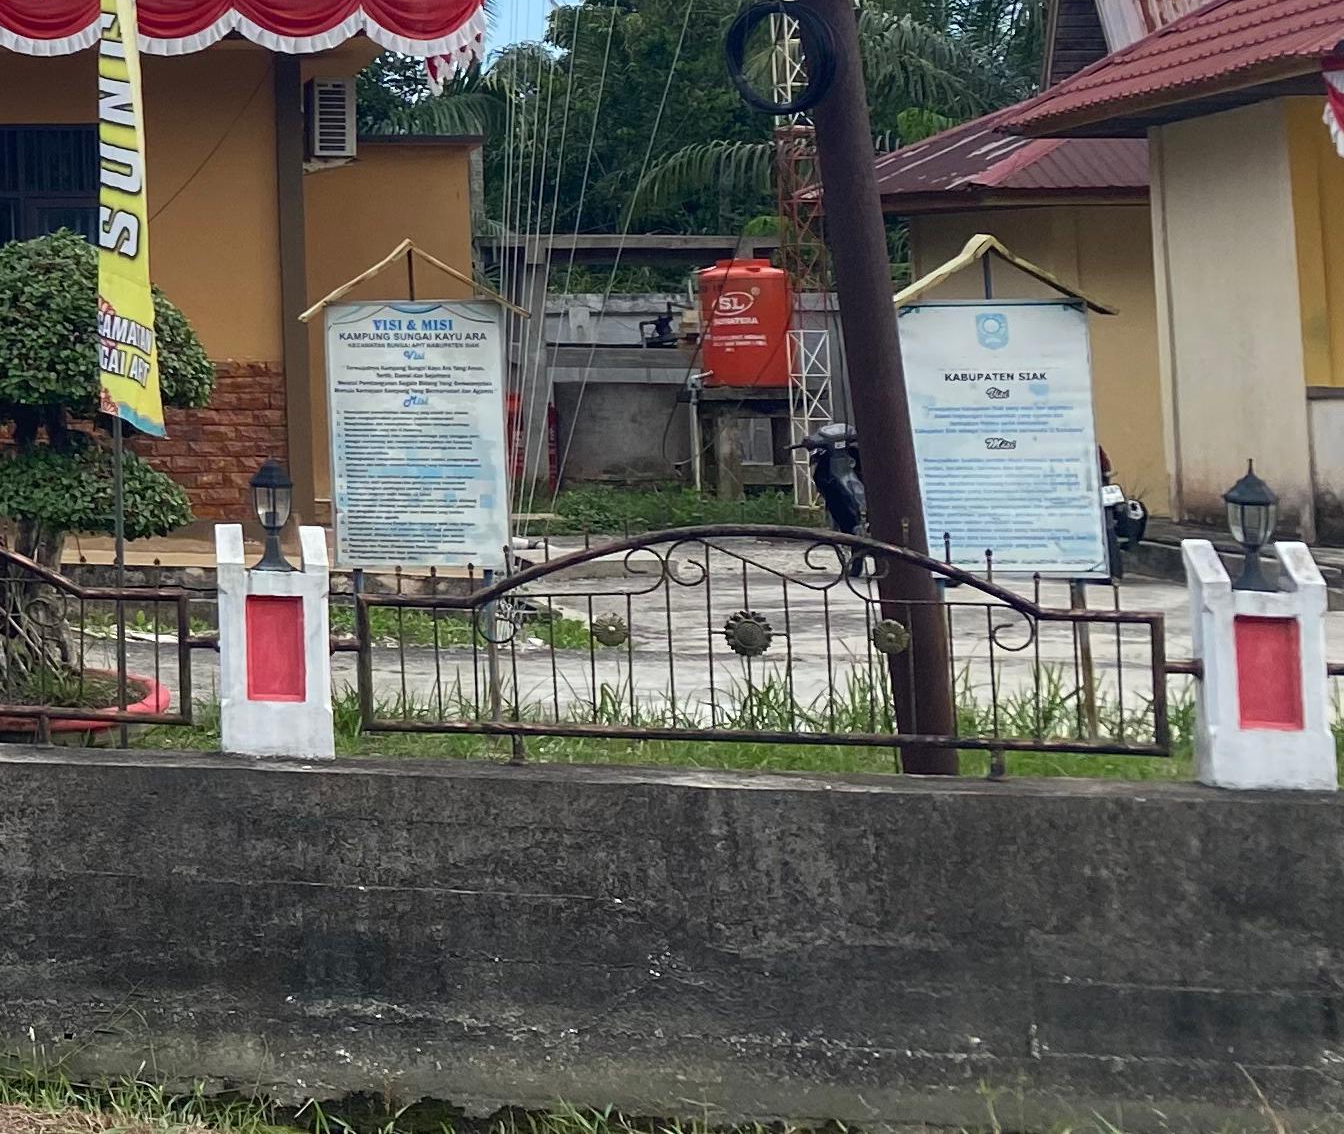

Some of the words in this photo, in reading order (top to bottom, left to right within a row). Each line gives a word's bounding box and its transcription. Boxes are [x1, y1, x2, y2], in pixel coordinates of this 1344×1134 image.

[718, 296, 745, 310] SL
[372, 319, 402, 331] VISI
[406, 320, 417, 331] &
[421, 319, 454, 331] MISI
[339, 332, 391, 341] KAMPUNG
[393, 332, 432, 341] SUNGAI
[435, 332, 463, 341] KAYU
[464, 332, 487, 341] ARA
[944, 372, 1014, 382] KABUPATEN
[1018, 372, 1047, 381] SIAK
